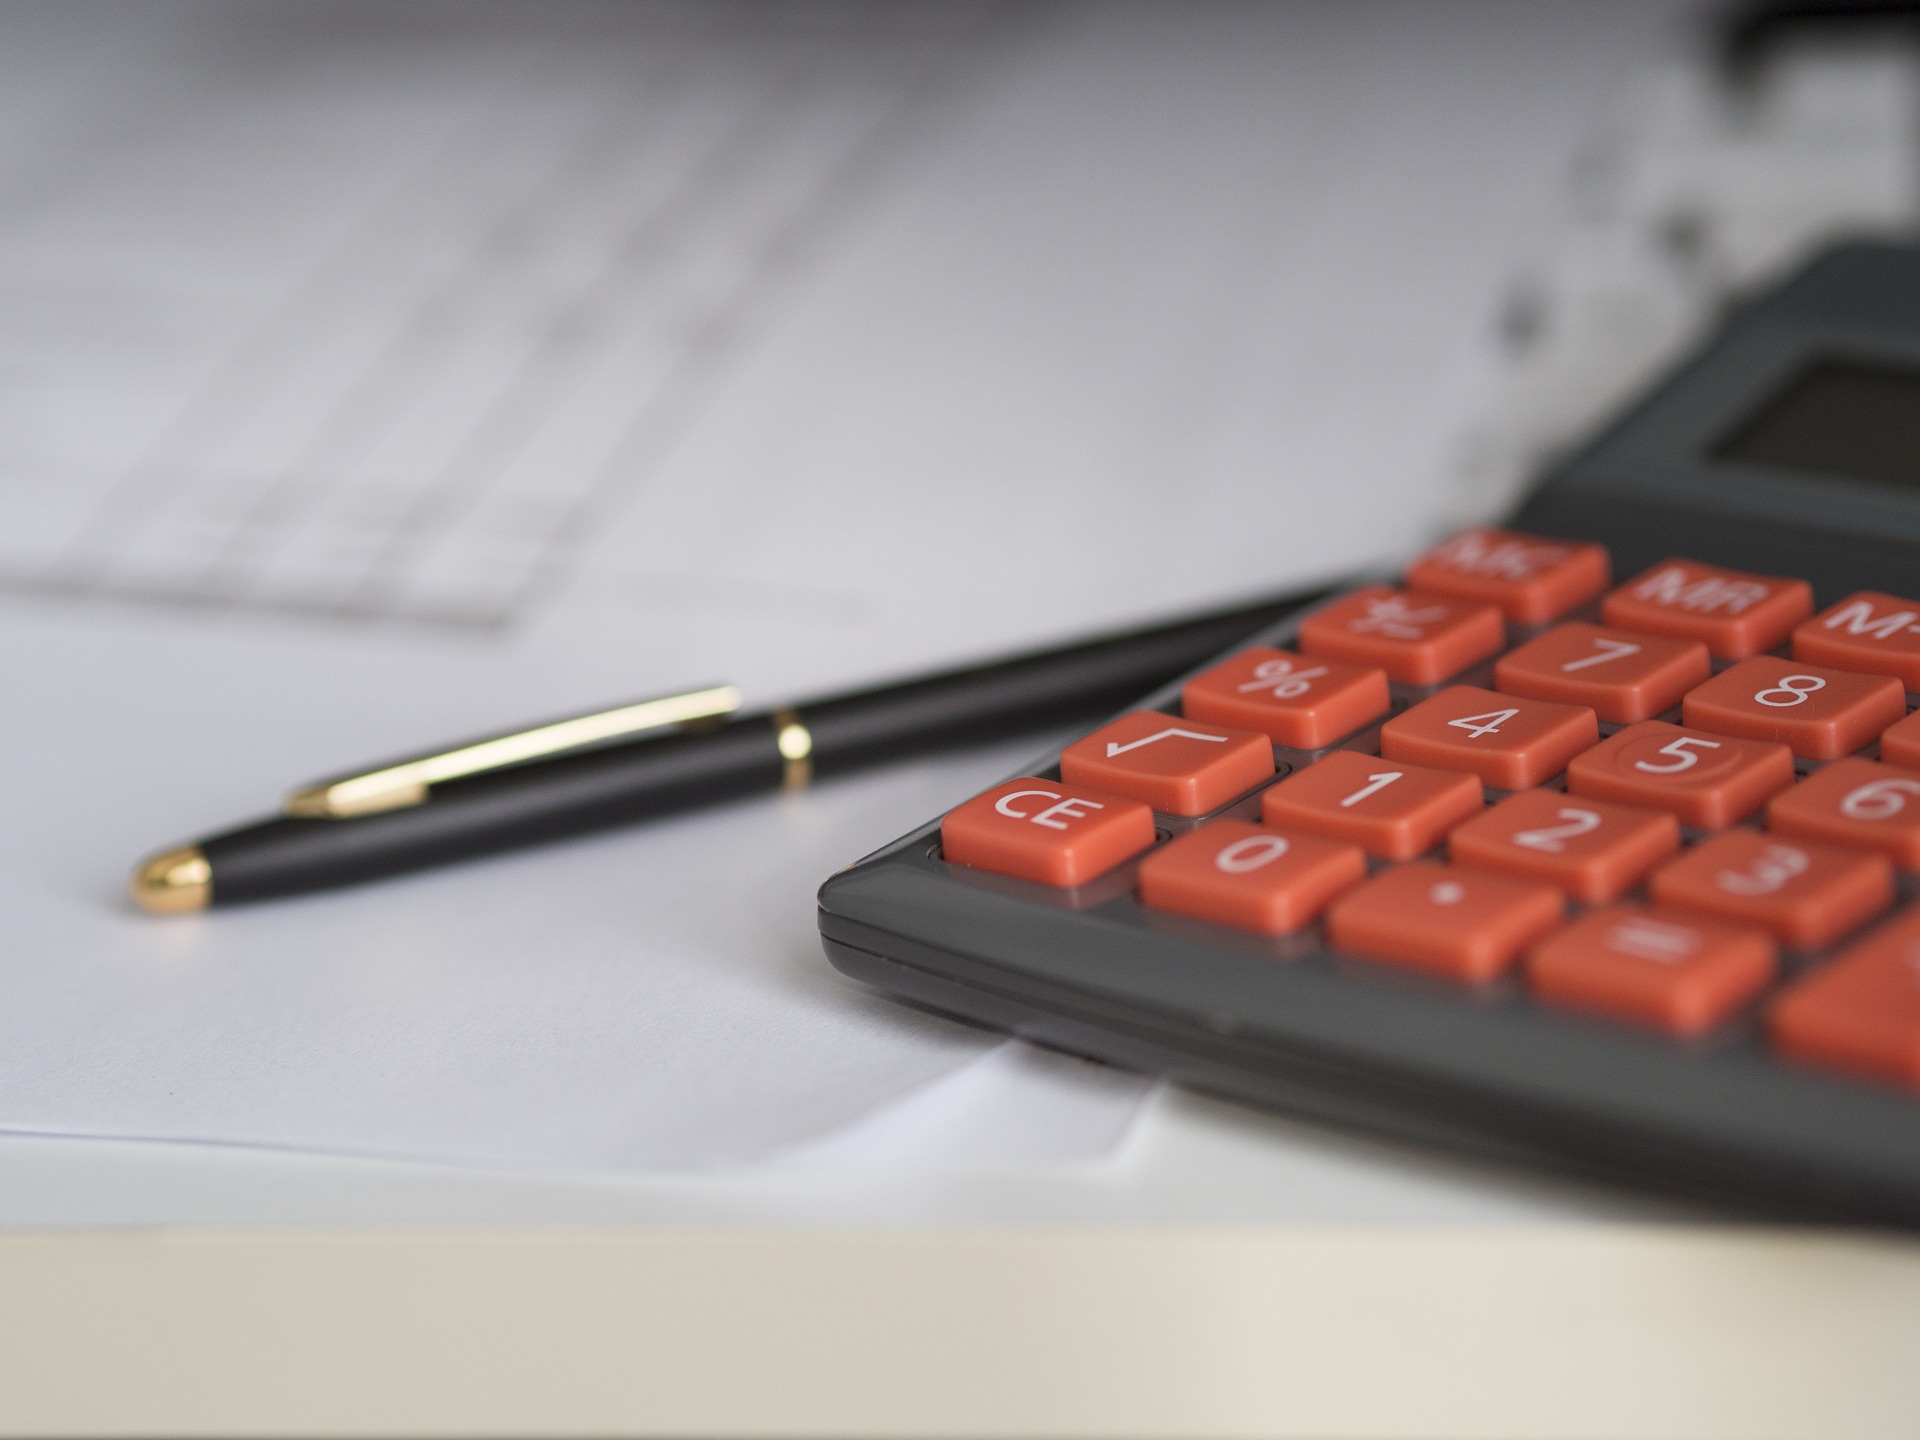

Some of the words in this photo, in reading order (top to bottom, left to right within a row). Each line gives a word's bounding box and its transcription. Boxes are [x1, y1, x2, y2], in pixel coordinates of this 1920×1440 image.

[1634, 567, 1769, 614] MR
[1561, 637, 1642, 672] 7
[1237, 658, 1328, 699] %
[1754, 675, 1827, 707] 8
[1447, 708, 1520, 739] 4
[1635, 736, 1722, 774] 5
[1340, 771, 1404, 807] 1
[1840, 778, 1920, 820] 6
[995, 790, 1104, 830] CE
[1513, 808, 1602, 853] 2
[1215, 834, 1290, 873] 0
[1717, 844, 1810, 897] 3
